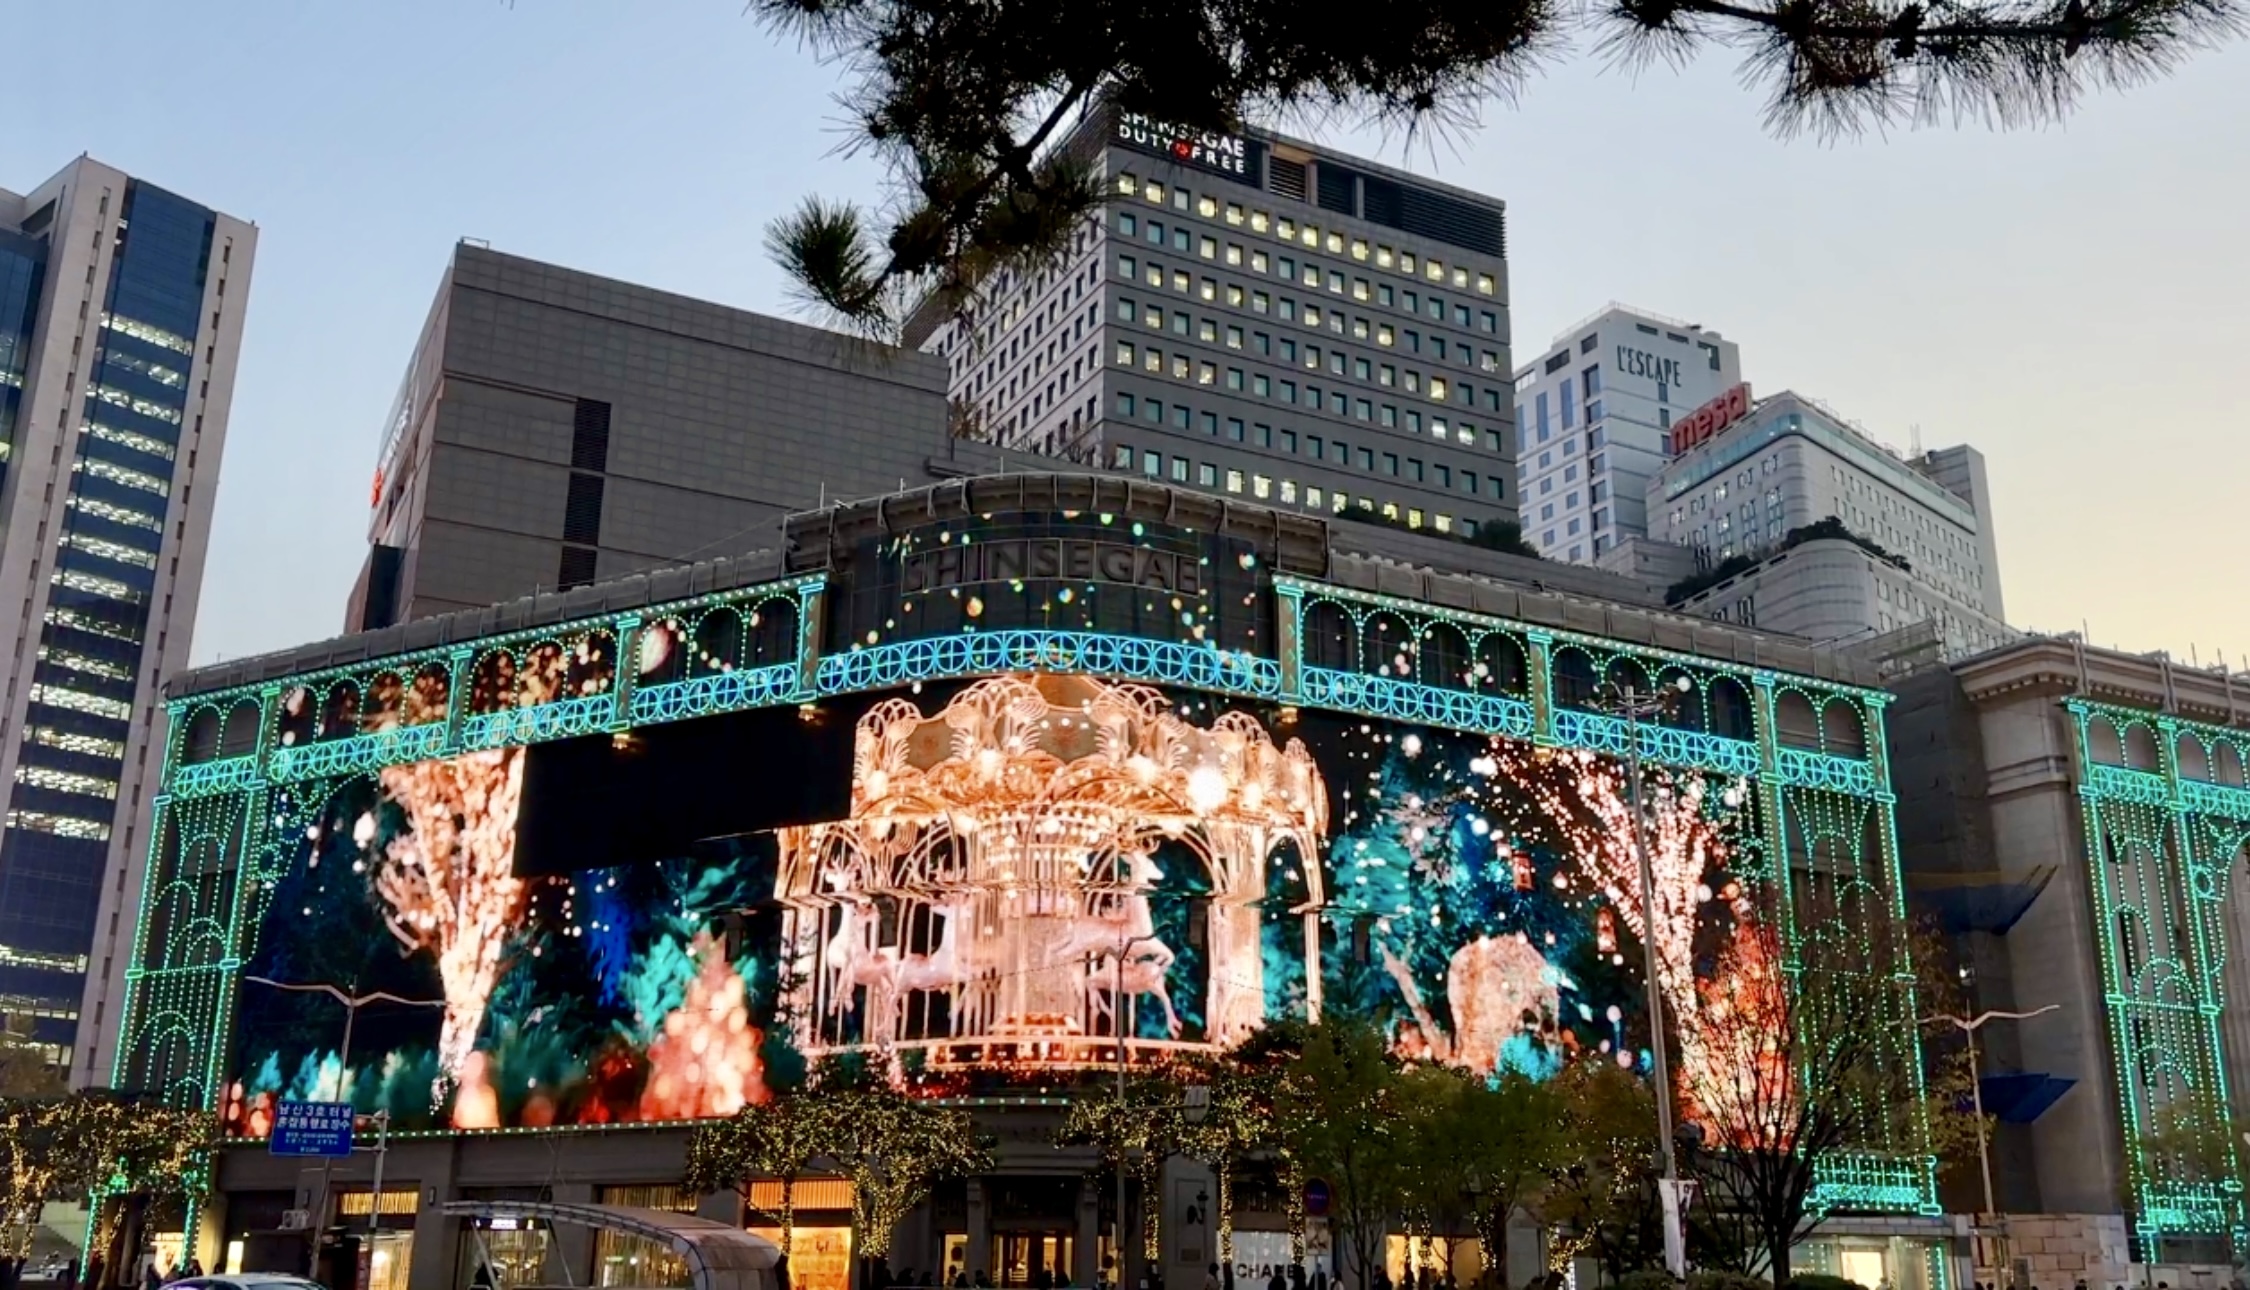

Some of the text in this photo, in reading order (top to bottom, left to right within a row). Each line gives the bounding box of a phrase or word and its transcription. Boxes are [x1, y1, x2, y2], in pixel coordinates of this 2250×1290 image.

[1118, 124, 1245, 174] DUTY FREE
[1616, 344, 1682, 388] L'ESCAPE
[1670, 385, 1749, 456] mesa
[905, 540, 1199, 595] SHINSEGAE
